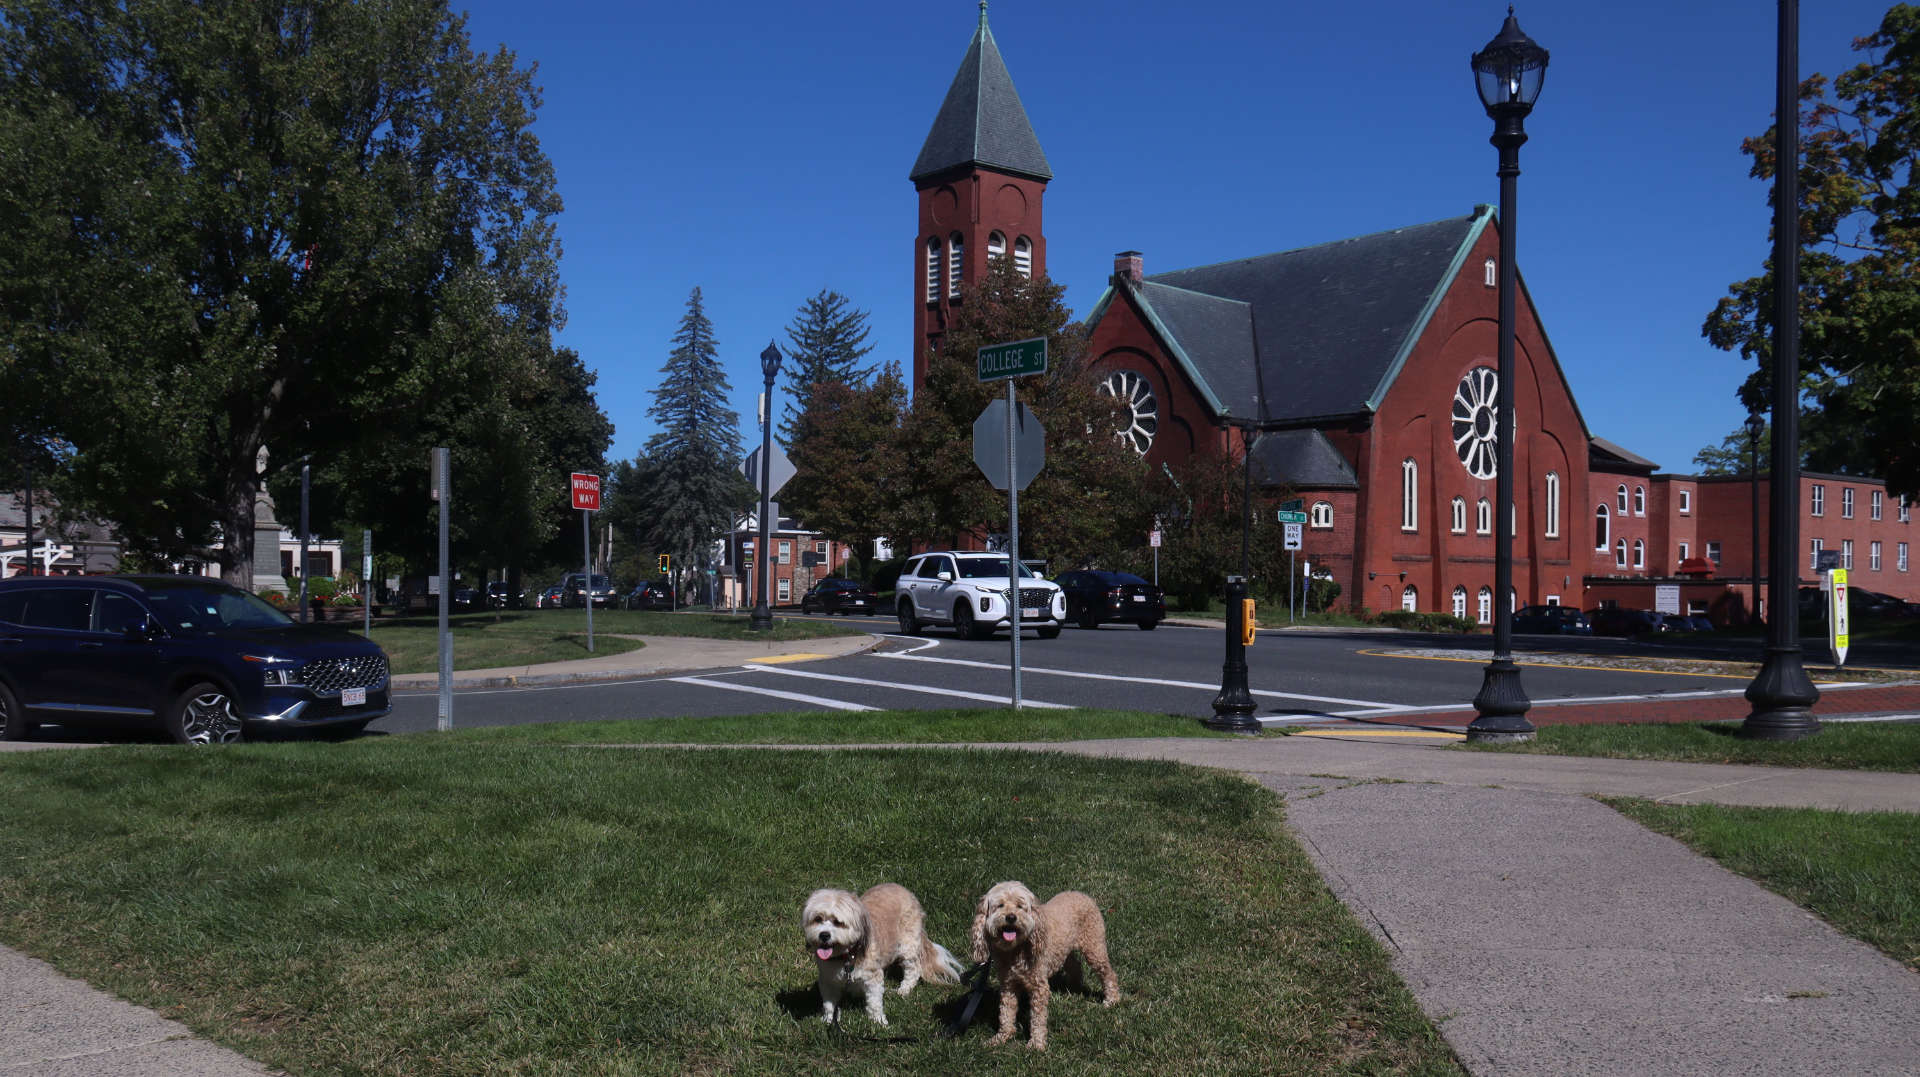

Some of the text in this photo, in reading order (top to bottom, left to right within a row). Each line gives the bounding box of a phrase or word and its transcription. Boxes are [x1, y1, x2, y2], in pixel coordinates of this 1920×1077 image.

[981, 349, 1044, 373] COLLEGE ST
[574, 480, 598, 491] WRONG
[579, 494, 594, 504] WAY
